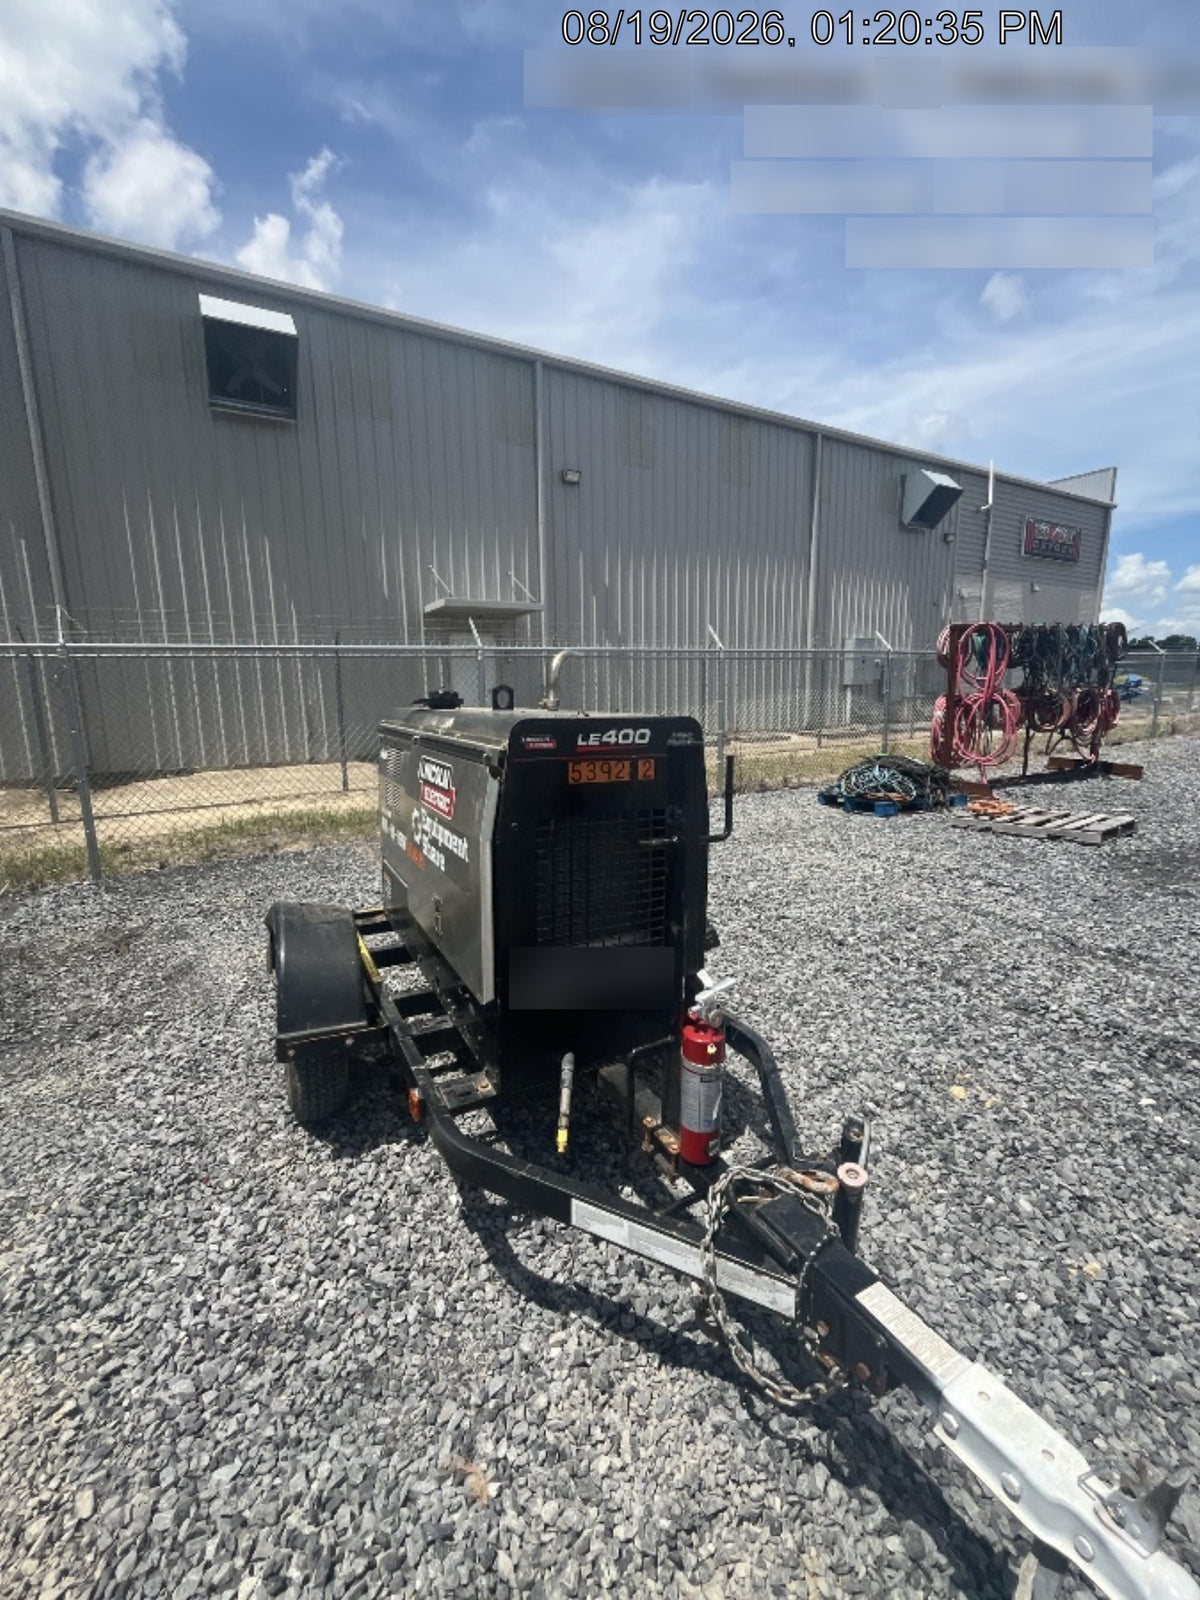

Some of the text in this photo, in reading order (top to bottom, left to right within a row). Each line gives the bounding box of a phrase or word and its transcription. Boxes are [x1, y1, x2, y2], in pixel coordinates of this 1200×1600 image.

[577, 728, 651, 746] LE400
[570, 761, 653, 782] 5392 2
